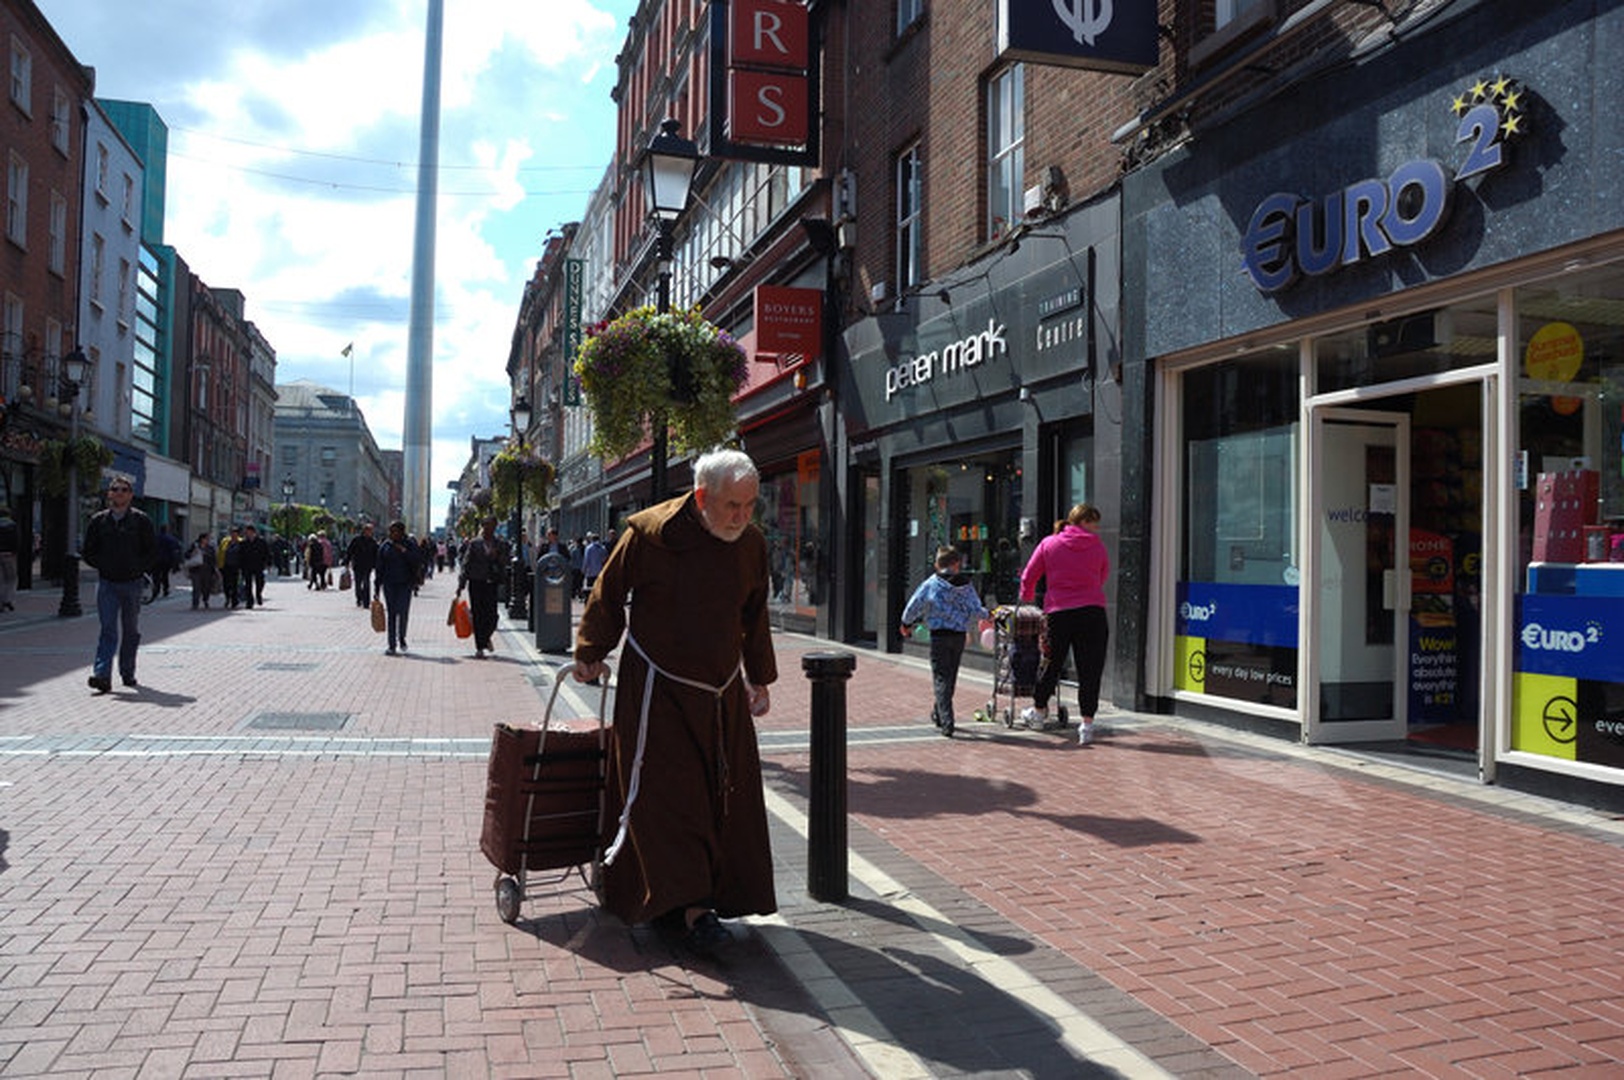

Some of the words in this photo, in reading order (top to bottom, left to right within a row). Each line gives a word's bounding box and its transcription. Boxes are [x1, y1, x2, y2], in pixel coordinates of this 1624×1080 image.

[569, 261, 581, 328] DUNNES
[764, 303, 815, 316] BOYERS
[1037, 317, 1083, 351] Centre
[886, 351, 938, 402] peter
[943, 318, 1005, 374] mark
[1212, 665, 1232, 679] every
[1234, 667, 1249, 680] day
[1250, 668, 1264, 680] low
[1266, 672, 1292, 685] prices
